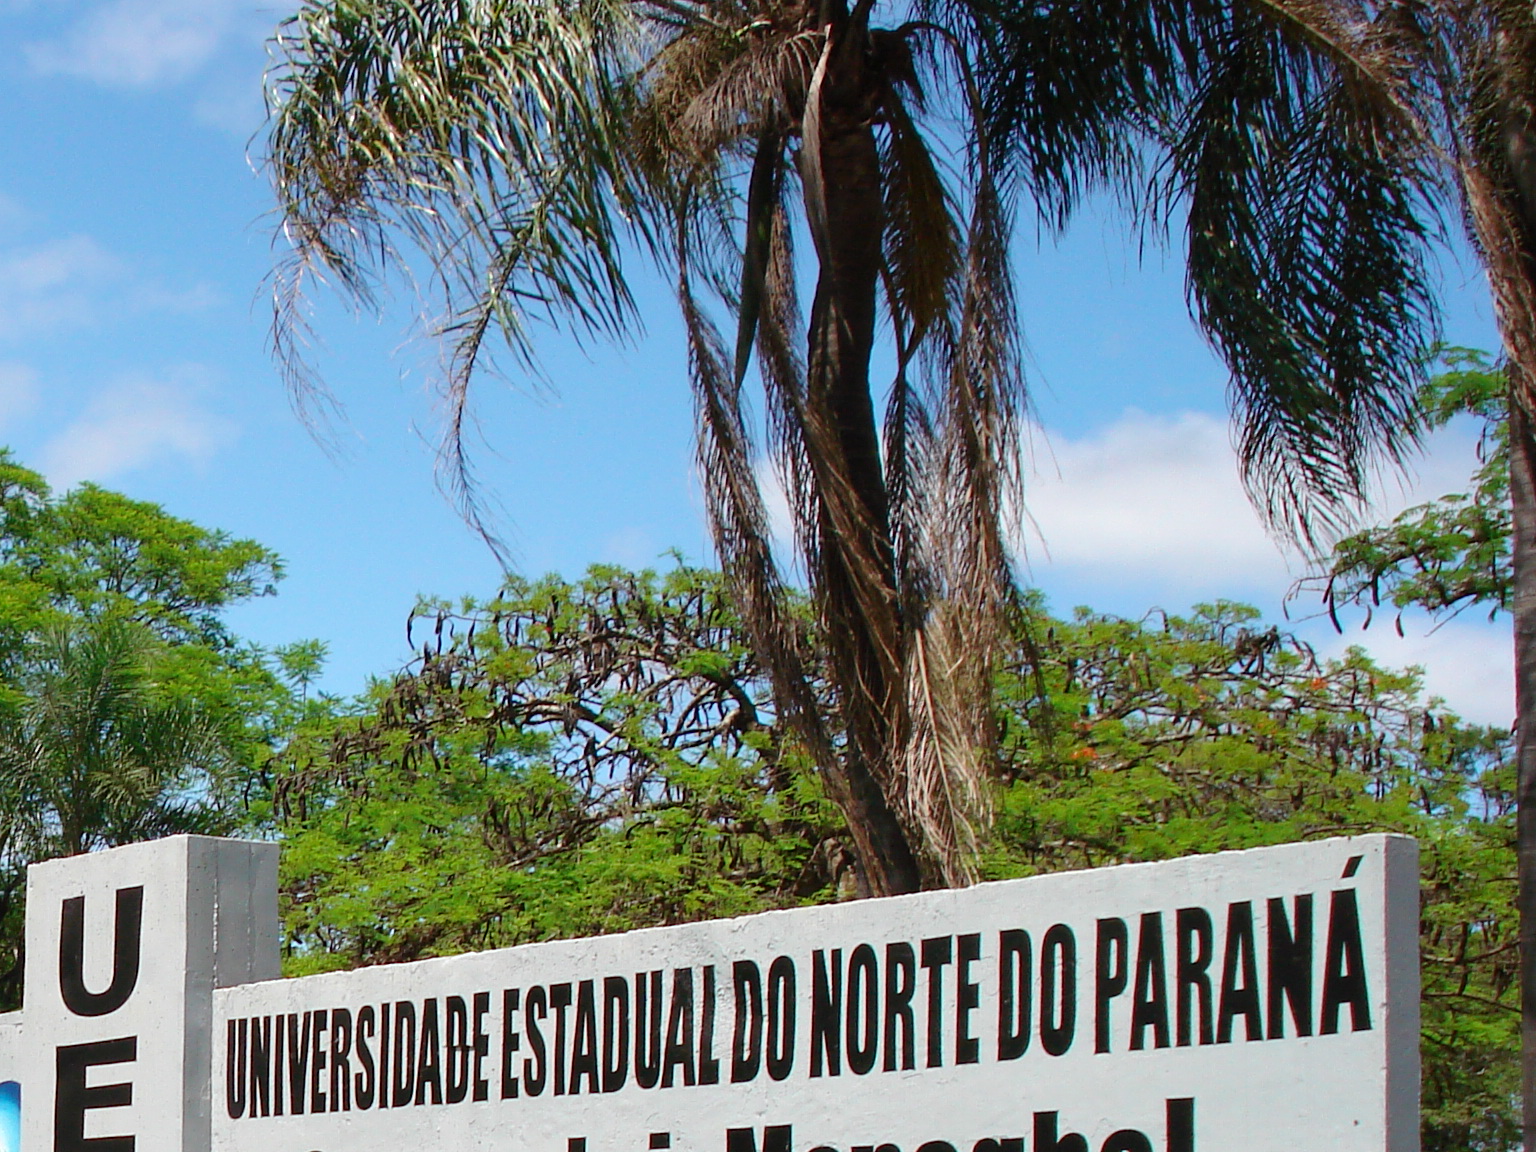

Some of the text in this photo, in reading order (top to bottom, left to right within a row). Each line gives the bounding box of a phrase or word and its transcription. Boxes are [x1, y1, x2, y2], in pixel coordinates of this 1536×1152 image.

[227, 855, 1373, 1119] UNIVERSIDADE ESTADUAL DO NORTE DO PARANÁ
